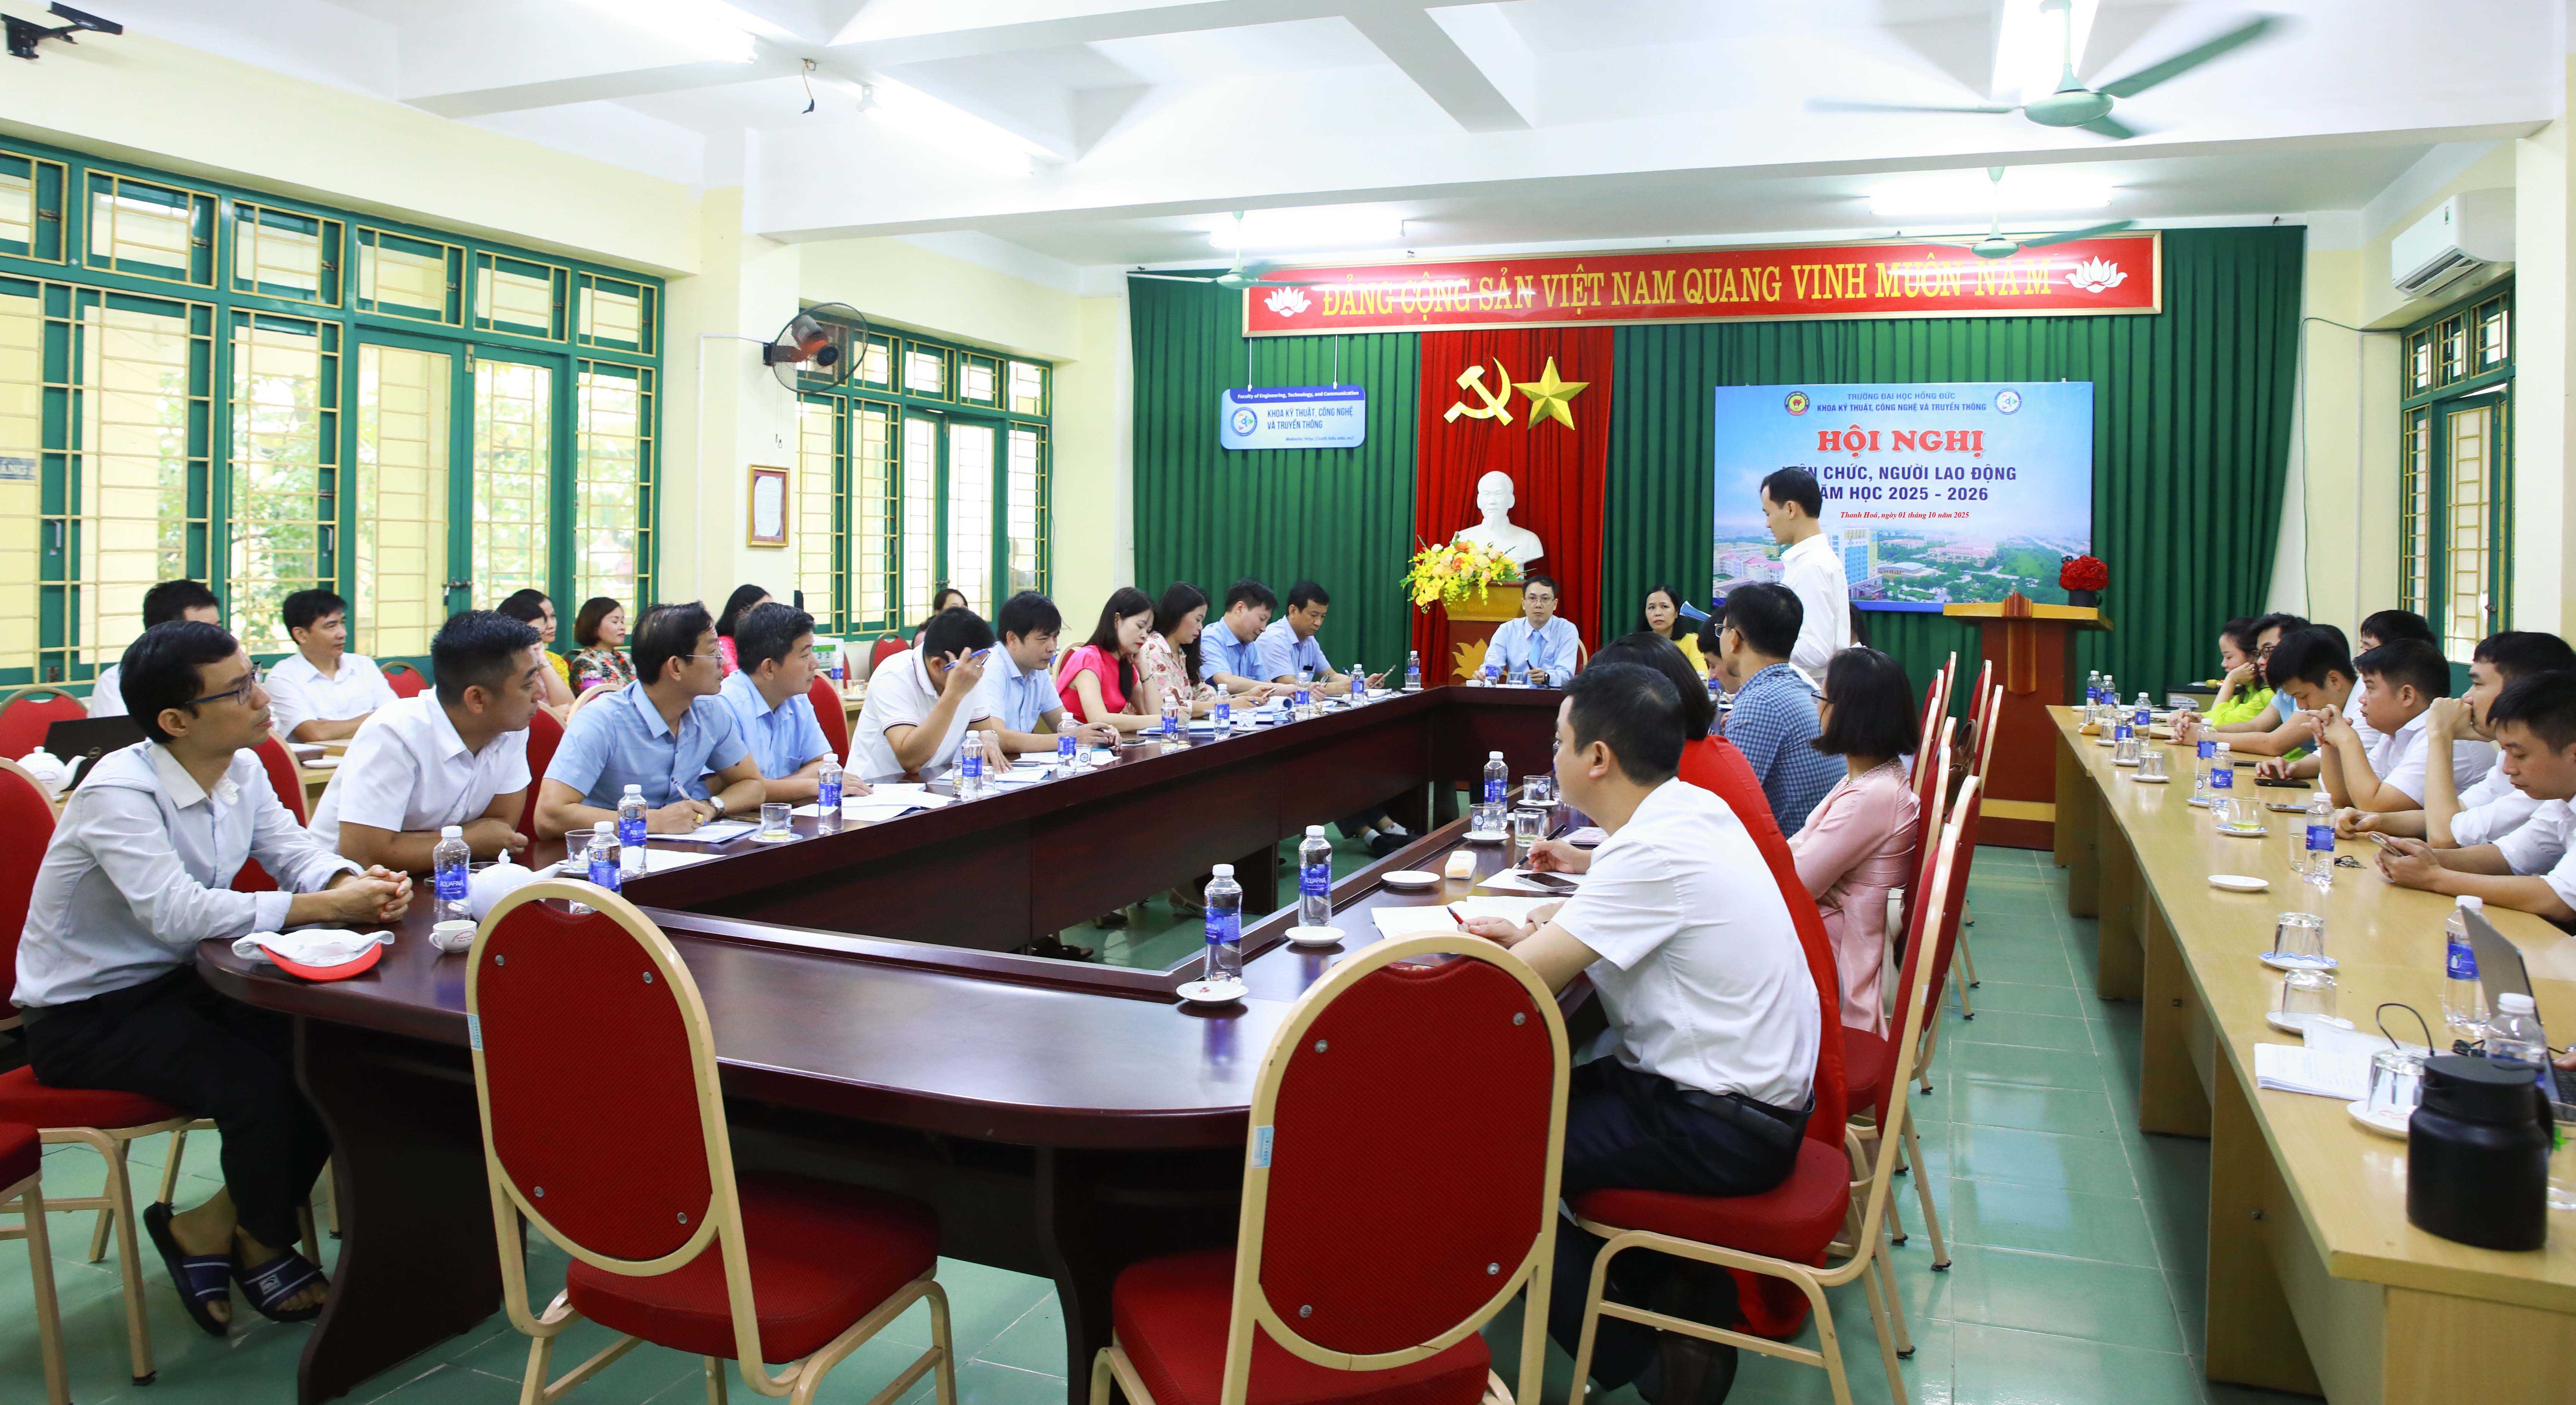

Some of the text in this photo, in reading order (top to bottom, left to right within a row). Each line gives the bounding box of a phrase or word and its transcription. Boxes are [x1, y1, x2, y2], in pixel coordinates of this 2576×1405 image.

[1322, 274, 1395, 316] ĐẢNG
[1401, 271, 1473, 322] CỘNG
[1479, 267, 1533, 311] SẢN
[1541, 263, 1604, 315] VIỆT
[1611, 270, 1676, 306] NAM
[1683, 266, 1782, 304] QUANG
[1791, 263, 1868, 300] VINH
[1875, 252, 1963, 298] MUÔN
[1881, 393, 1894, 402] ĐẠI
[1896, 393, 1912, 401] HỌC
[1267, 409, 1283, 417] KHOA
[1318, 406, 1335, 416] CÔNG
[1337, 406, 1353, 417] NGHỆ
[1875, 403, 1895, 411] CÔNG
[1898, 403, 1917, 412] NGHỆ
[1919, 402, 1929, 411] VÀ
[1962, 402, 1986, 411] THÔNG
[1267, 421, 1275, 429] VÀ
[1302, 419, 1323, 429] THÔNG
[1817, 424, 1985, 458] HỘI NGHỊ
[1824, 463, 1872, 481] CHỨC,
[1879, 463, 1928, 480] NGƯỜI
[1935, 467, 1965, 480] LAO
[1971, 464, 2016, 483] ĐỘNG
[1820, 484, 1843, 499] ĂM
[1850, 486, 1882, 503] HỌC
[1888, 487, 1928, 500] 2025
[1947, 487, 1988, 500] 2026
